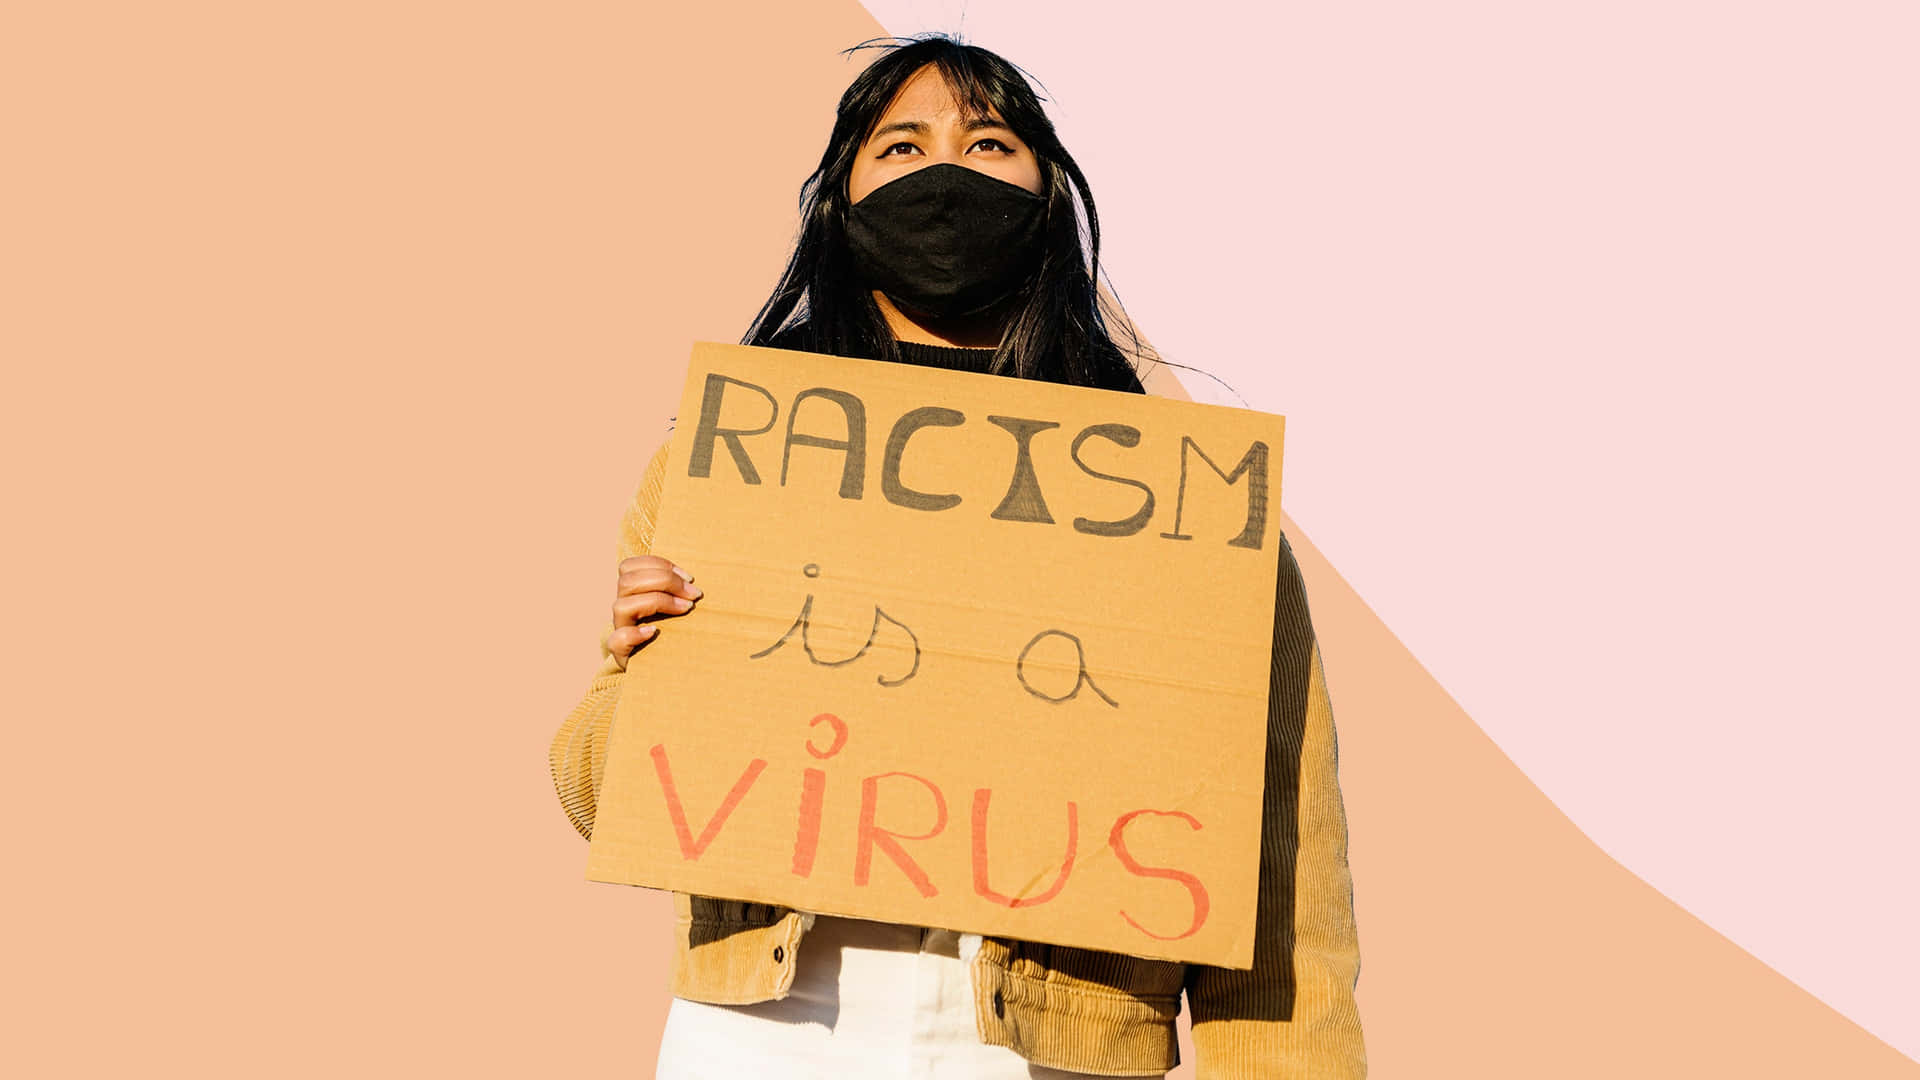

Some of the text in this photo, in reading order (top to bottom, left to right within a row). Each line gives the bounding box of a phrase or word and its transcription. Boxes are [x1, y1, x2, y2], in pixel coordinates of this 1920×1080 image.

[687, 373, 1269, 550] RACISM
[750, 563, 1119, 708] is a
